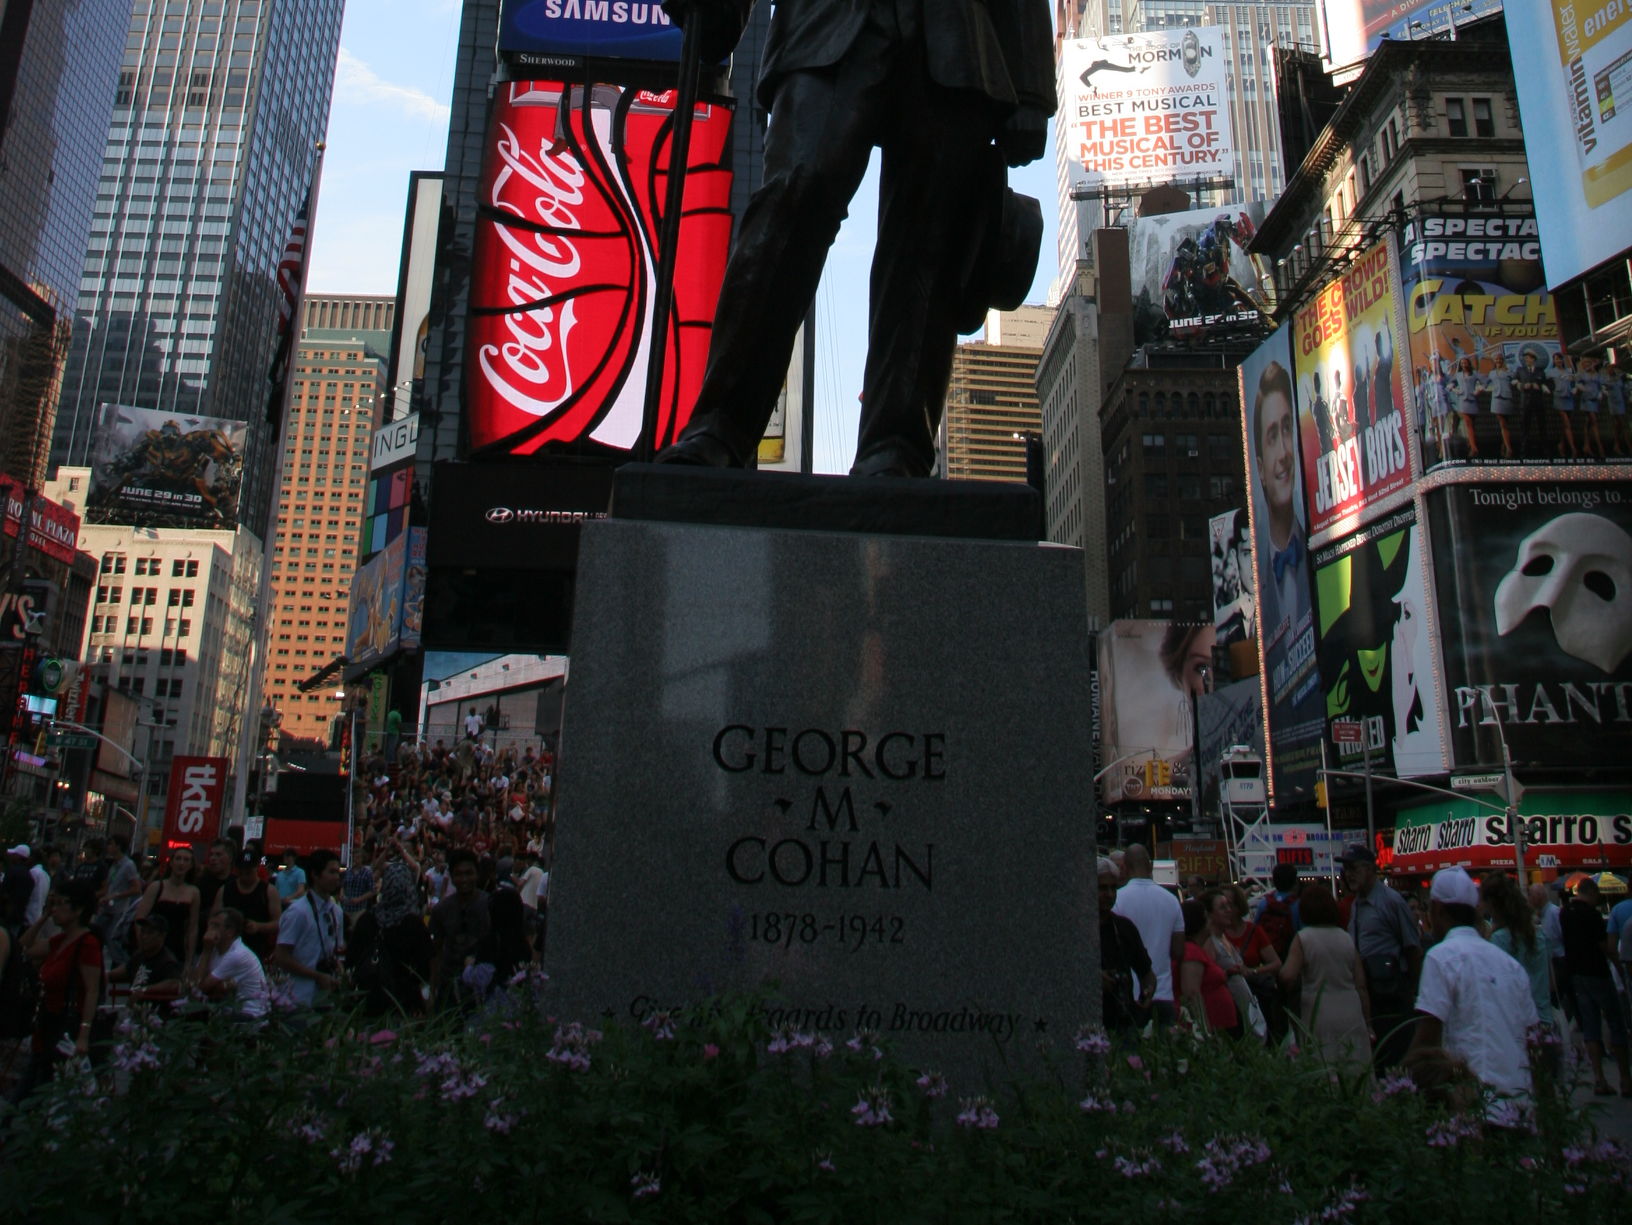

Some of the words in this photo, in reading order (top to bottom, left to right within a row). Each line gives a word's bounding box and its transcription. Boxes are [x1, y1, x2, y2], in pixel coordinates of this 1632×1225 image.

[1391, 9, 1398, 17] A
[519, 54, 575, 67] SHERWOOD
[1078, 90, 1123, 102] WINNER
[1127, 90, 1133, 98] 9
[1136, 87, 1167, 97] TONY
[1167, 82, 1216, 94] AWARDS
[1079, 102, 1125, 118] BEST
[1132, 94, 1217, 113] MUSICAL
[1144, 110, 1217, 135] BEST
[1080, 135, 1182, 159] MUSICAL
[1187, 131, 1220, 149] OF
[1081, 156, 1125, 173] THIS
[1405, 223, 1414, 246] A
[479, 122, 585, 417] Coca-Cola
[1331, 245, 1388, 308] CROWD
[1169, 316, 1202, 328] JUNE
[1238, 310, 1258, 320] 3D
[1409, 280, 1557, 334] CATCH
[1302, 308, 1342, 357] GOES
[1485, 326, 1501, 337] IF
[1504, 326, 1537, 337] YOU
[1315, 433, 1364, 515] JERSEY
[1367, 409, 1406, 483] BOYS
[120, 486, 153, 497] JUNE
[154, 489, 172, 500] 29
[184, 493, 203, 503] 3D
[1469, 487, 1534, 510] Tonight
[1537, 487, 1600, 509] belongs
[45, 518, 75, 547] PLAZA
[1454, 681, 1632, 727] PHANT
[713, 724, 947, 781] GEORGE
[178, 764, 216, 834] tkts
[806, 785, 859, 834] M
[1397, 820, 1431, 854] sbarro
[1437, 812, 1476, 850] sbarro
[725, 836, 934, 893] COHAN
[1179, 856, 1227, 873] GIFTS
[1278, 849, 1312, 865] GIFTS
[749, 912, 906, 953] 1878-1942
[856, 1003, 881, 1033] to
[888, 1002, 1022, 1045] Broadway
